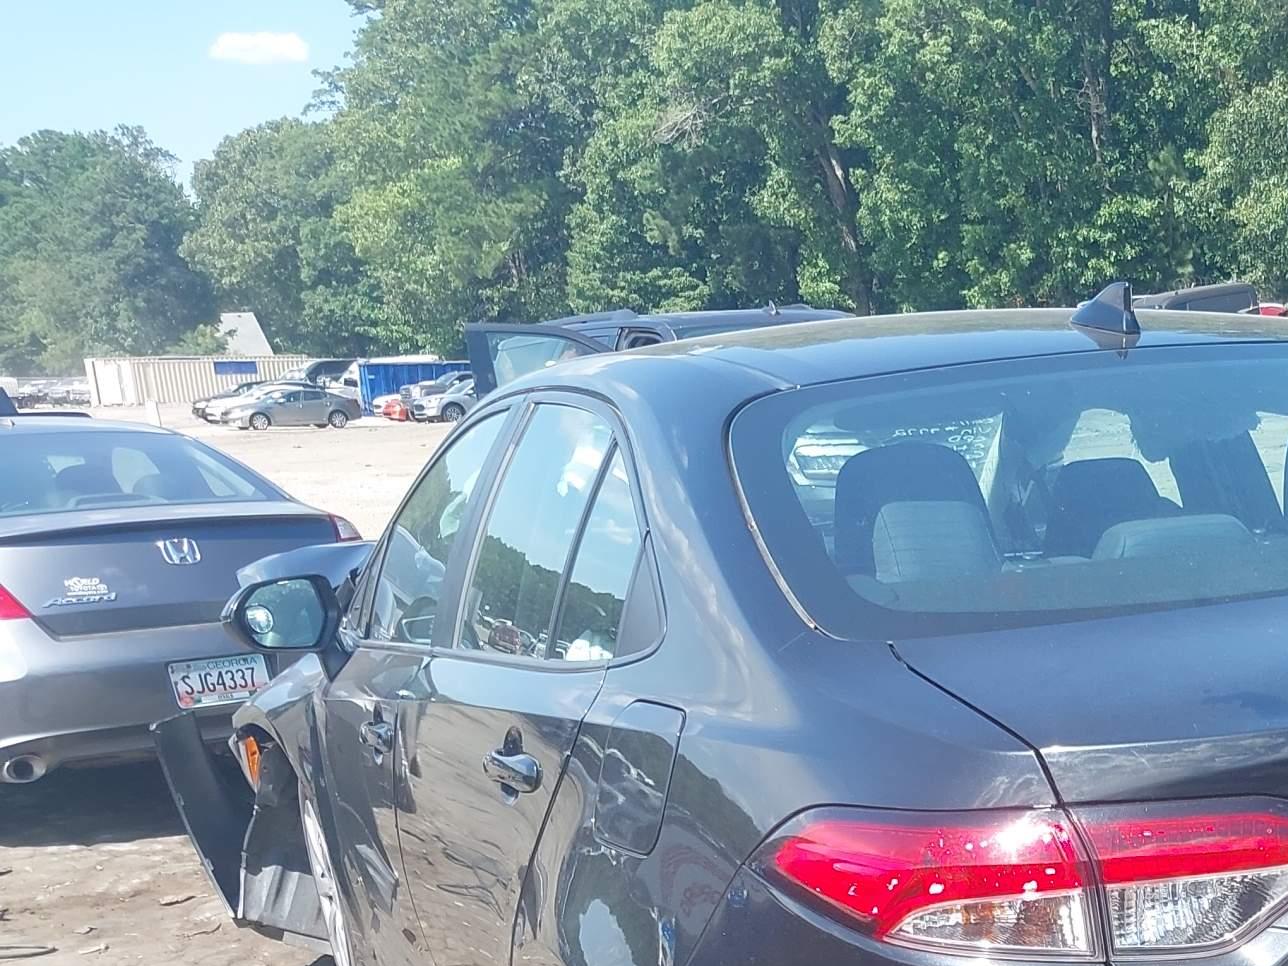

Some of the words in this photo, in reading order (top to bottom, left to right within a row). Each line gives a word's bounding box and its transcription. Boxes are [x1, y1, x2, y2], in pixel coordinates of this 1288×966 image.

[42, 592, 116, 608] Accord
[206, 656, 257, 671] GEORGIA
[180, 667, 256, 696] SJG4337
